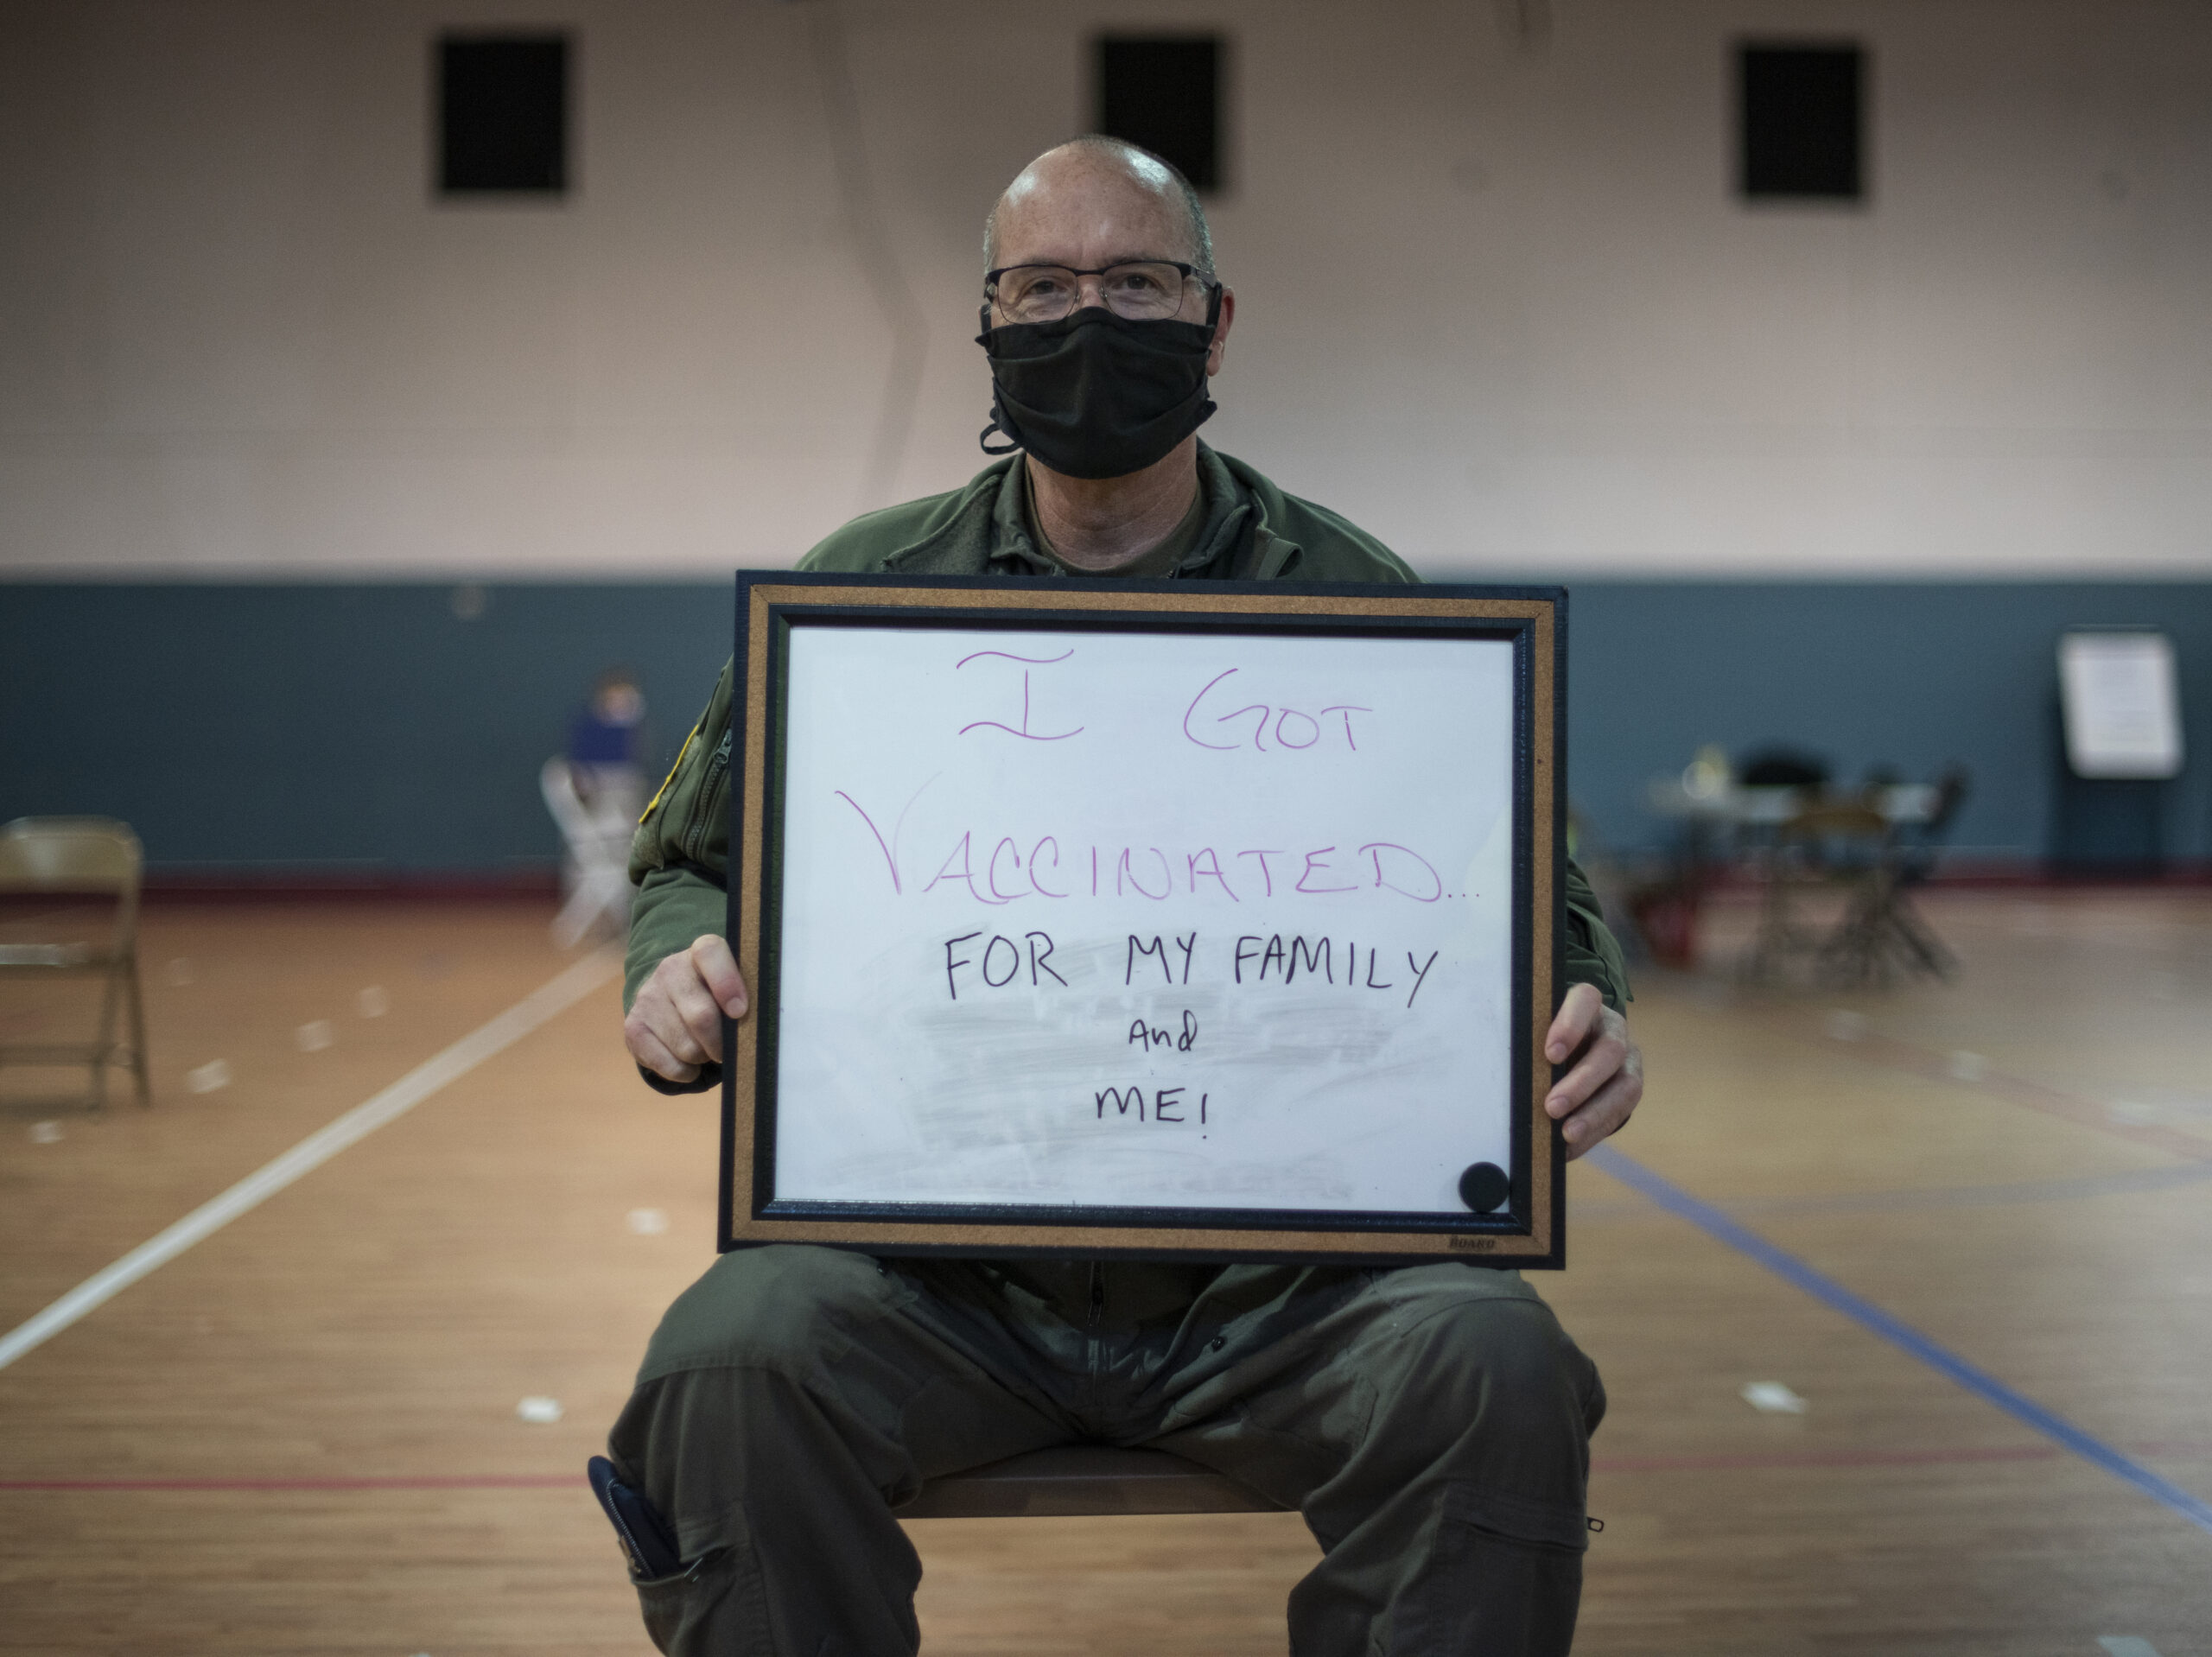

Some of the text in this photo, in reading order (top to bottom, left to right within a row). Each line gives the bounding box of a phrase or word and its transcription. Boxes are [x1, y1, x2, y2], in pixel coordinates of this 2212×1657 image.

[957, 649, 1084, 740] I
[944, 931, 1439, 1008] FOR MY FAMILY
[1096, 1086, 1208, 1140] ME!
